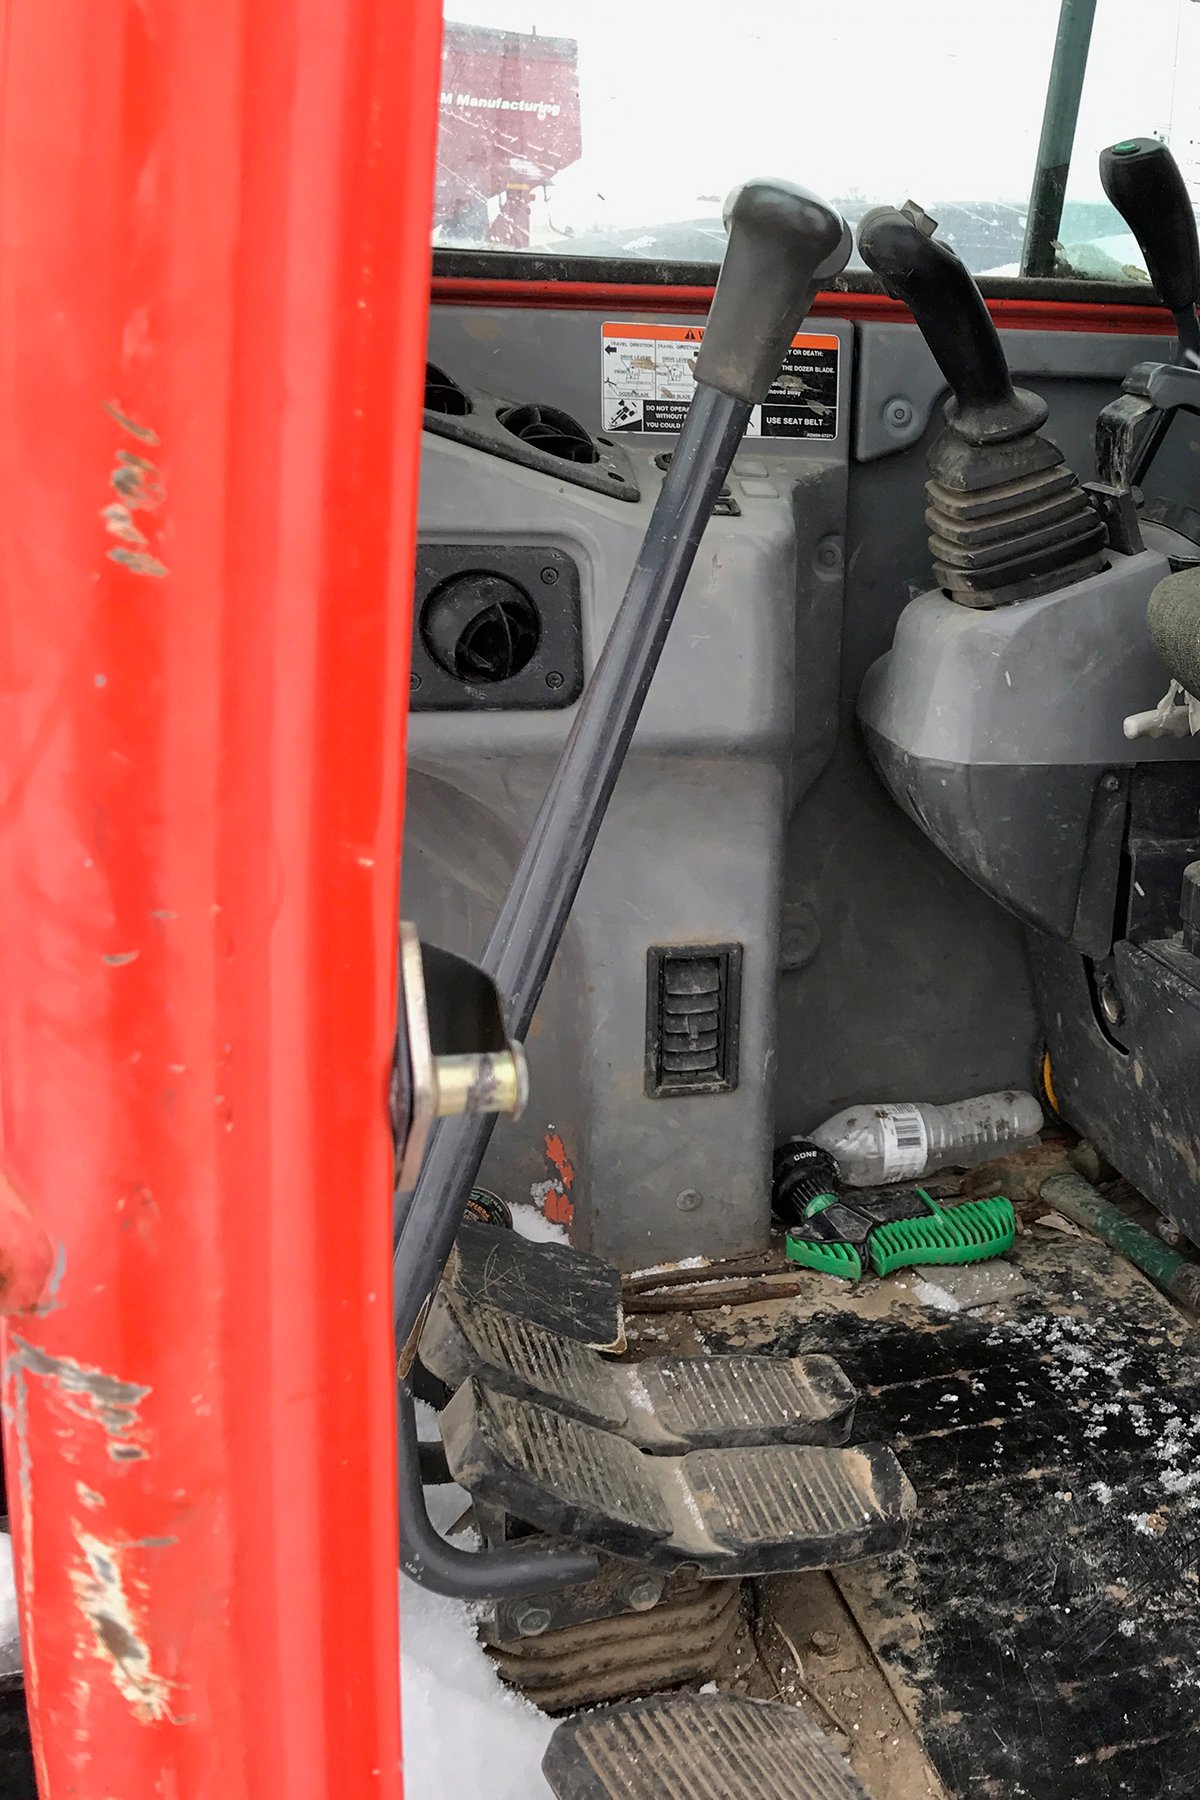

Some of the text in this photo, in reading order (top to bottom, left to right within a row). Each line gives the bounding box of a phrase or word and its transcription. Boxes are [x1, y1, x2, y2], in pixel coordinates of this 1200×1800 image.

[456, 93, 560, 116] Manufacturing
[815, 366, 835, 374] BLADE.
[766, 416, 824, 426] USE SEAT BELT
[793, 1150, 817, 1162] CONE
